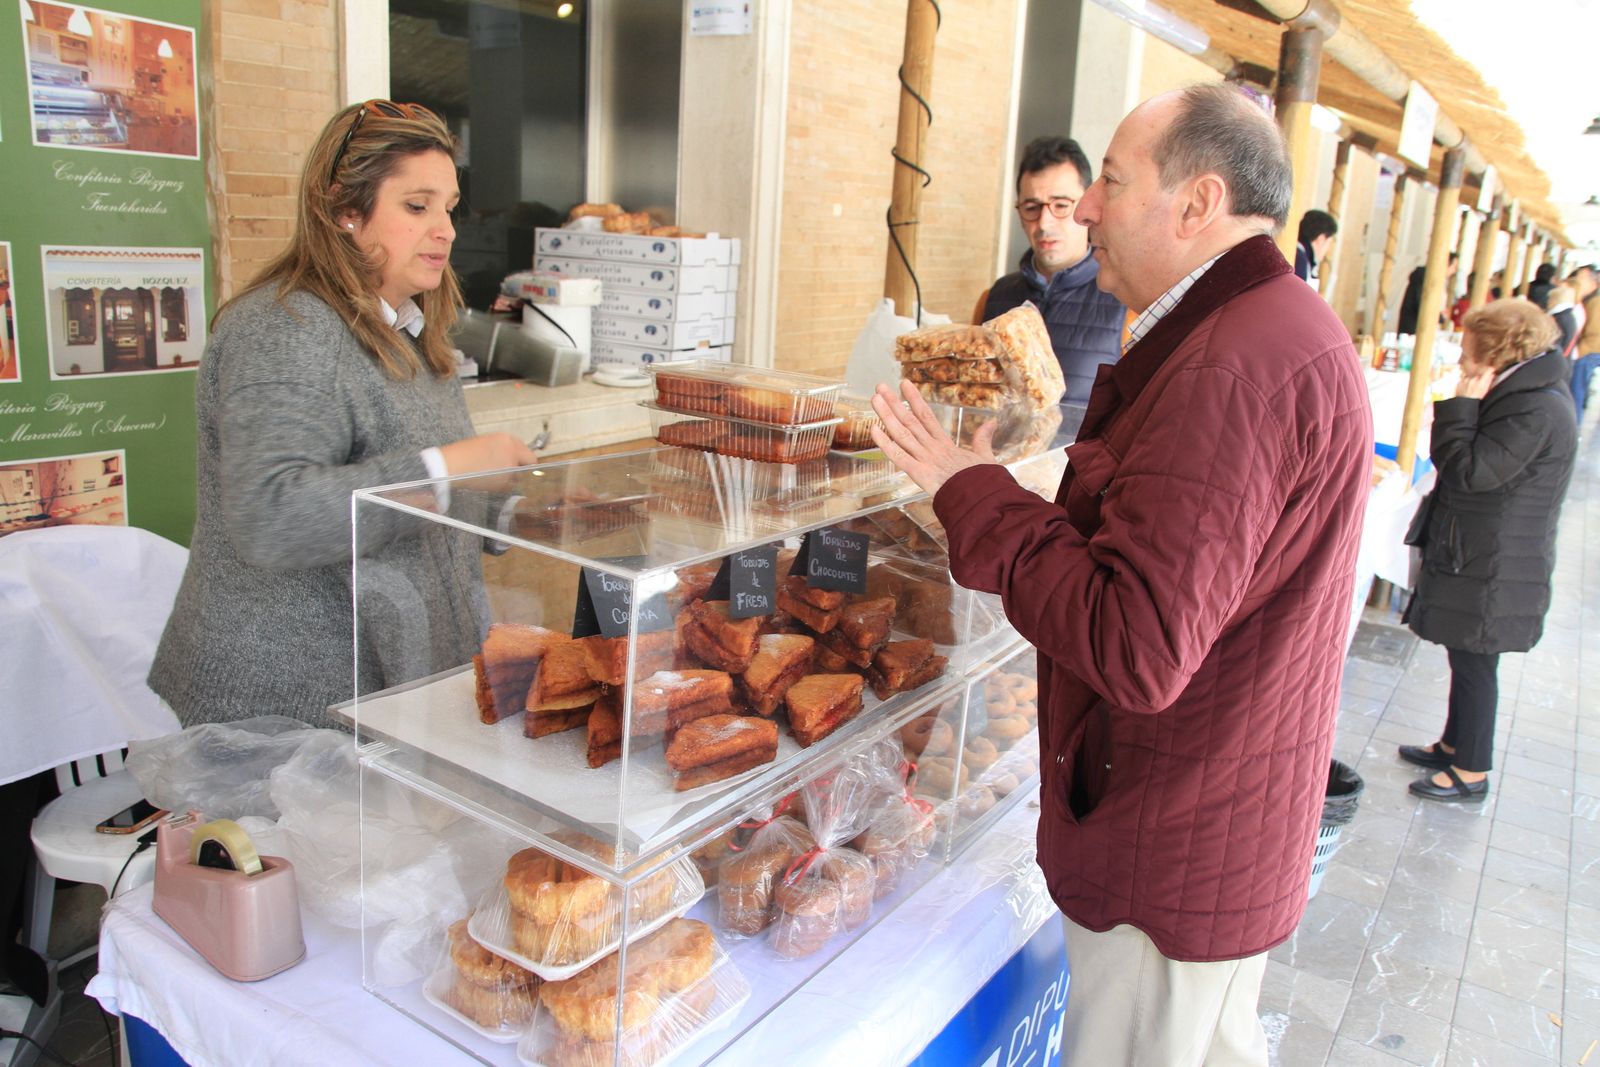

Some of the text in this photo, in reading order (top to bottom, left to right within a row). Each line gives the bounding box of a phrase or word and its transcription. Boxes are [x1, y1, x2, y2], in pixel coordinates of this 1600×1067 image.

[81, 192, 167, 214] Fuenteheridos
[0, 412, 167, 443] Maravillas (Aracena)
[736, 591, 769, 611] FRESA
